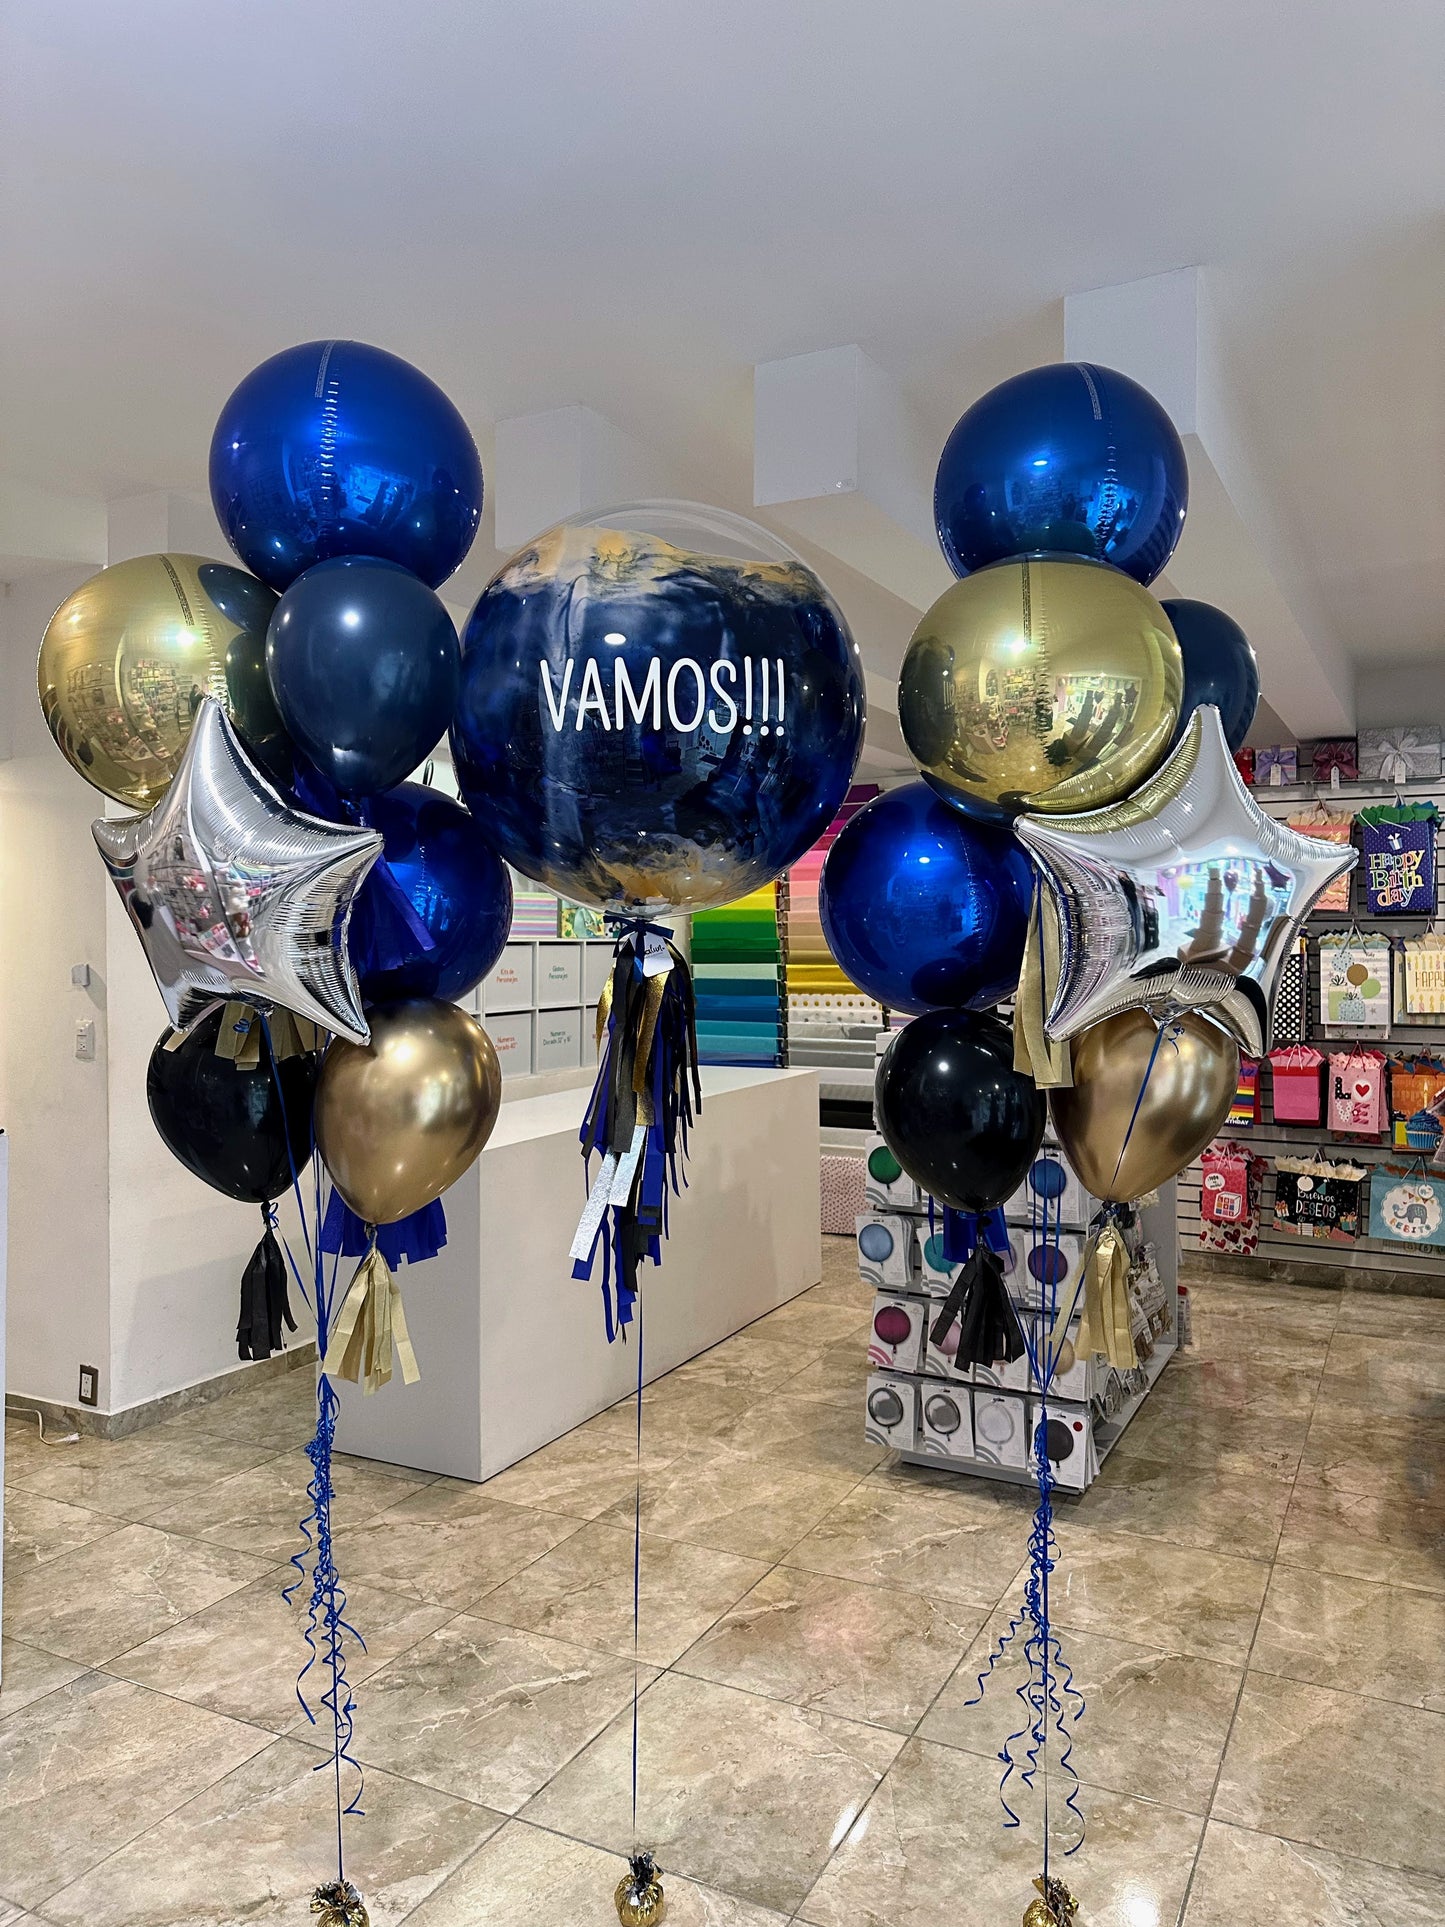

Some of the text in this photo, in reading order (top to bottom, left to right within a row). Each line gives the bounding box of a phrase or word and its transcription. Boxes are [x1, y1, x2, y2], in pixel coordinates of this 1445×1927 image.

[540, 656, 785, 736] VAMOS!!!
[1368, 849, 1425, 870] Happy
[1369, 868, 1425, 890] Birth
[1376, 886, 1415, 908] day
[1415, 970, 1445, 988] HAPPY
[1297, 1188, 1335, 1203] Buenos
[1295, 1199, 1337, 1219] DESEOS
